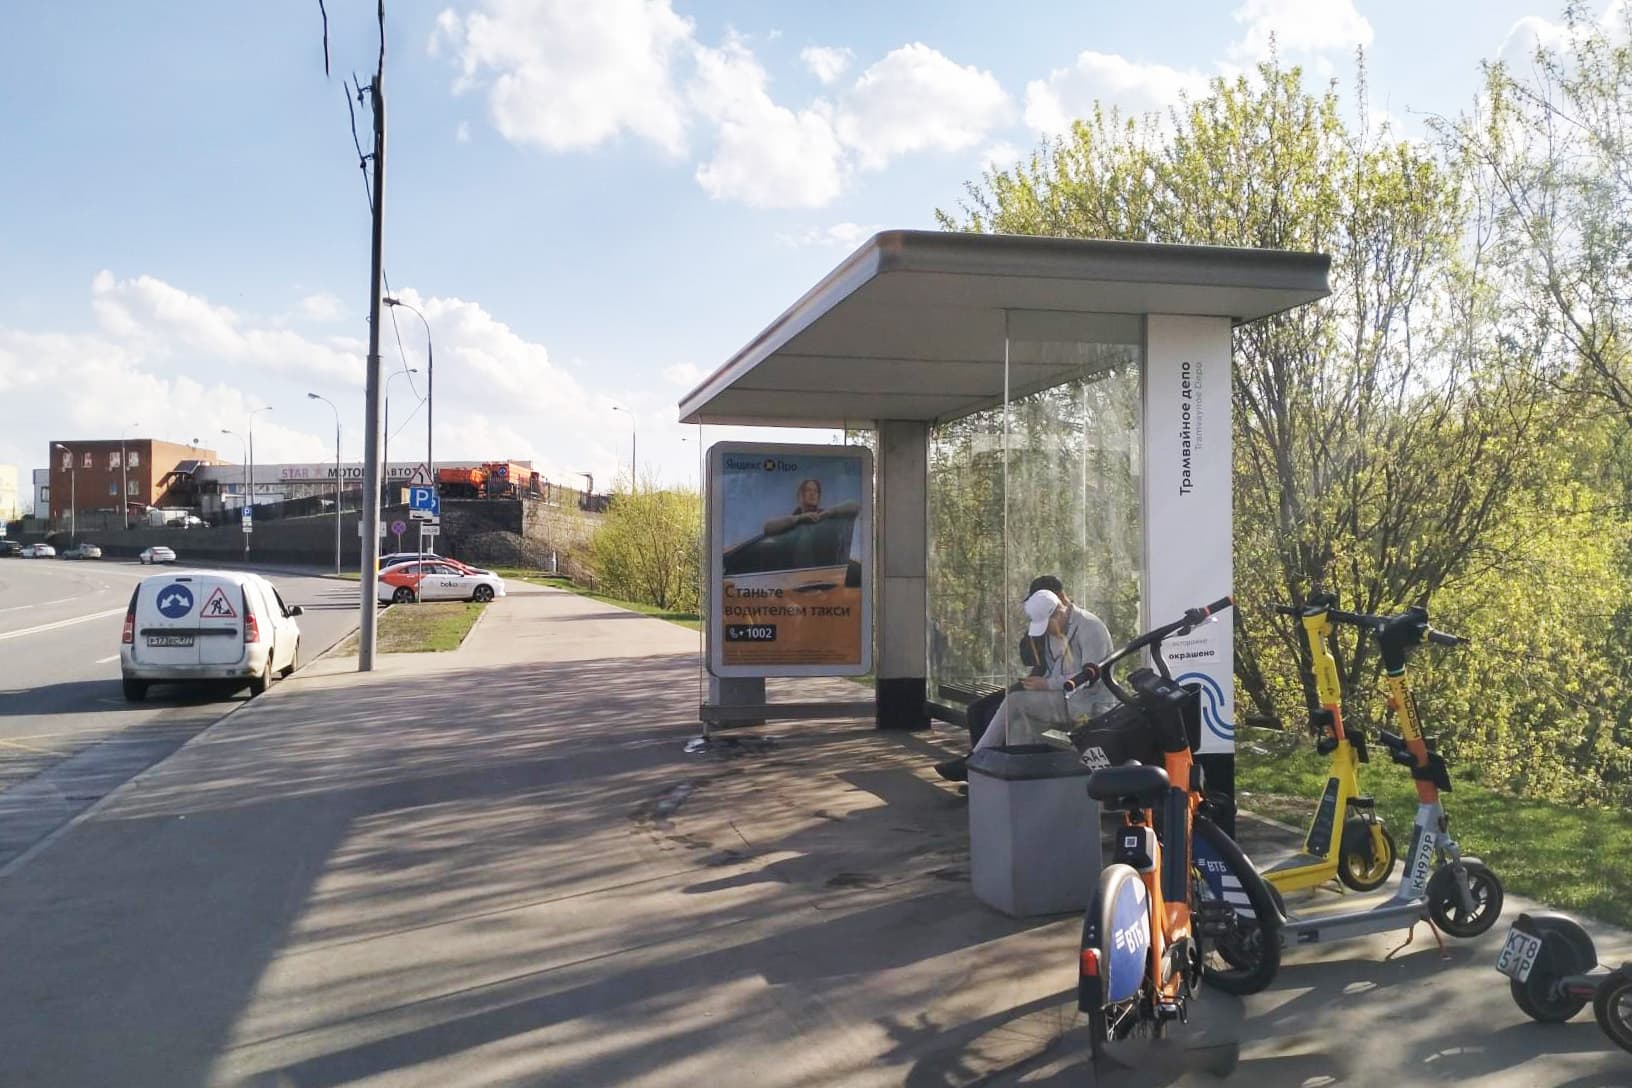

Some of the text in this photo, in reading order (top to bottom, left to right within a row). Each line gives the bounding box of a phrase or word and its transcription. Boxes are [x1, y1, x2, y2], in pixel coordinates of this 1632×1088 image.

[1179, 361, 1193, 496] Трамвайное депо
[281, 467, 309, 478] STAR
[777, 460, 798, 472] Про
[724, 584, 784, 598] Станьте
[724, 604, 850, 618] водителем такси
[1168, 649, 1215, 661] окрашено
[1207, 860, 1228, 873] ВТБ
[1124, 919, 1144, 955] ВТБ
